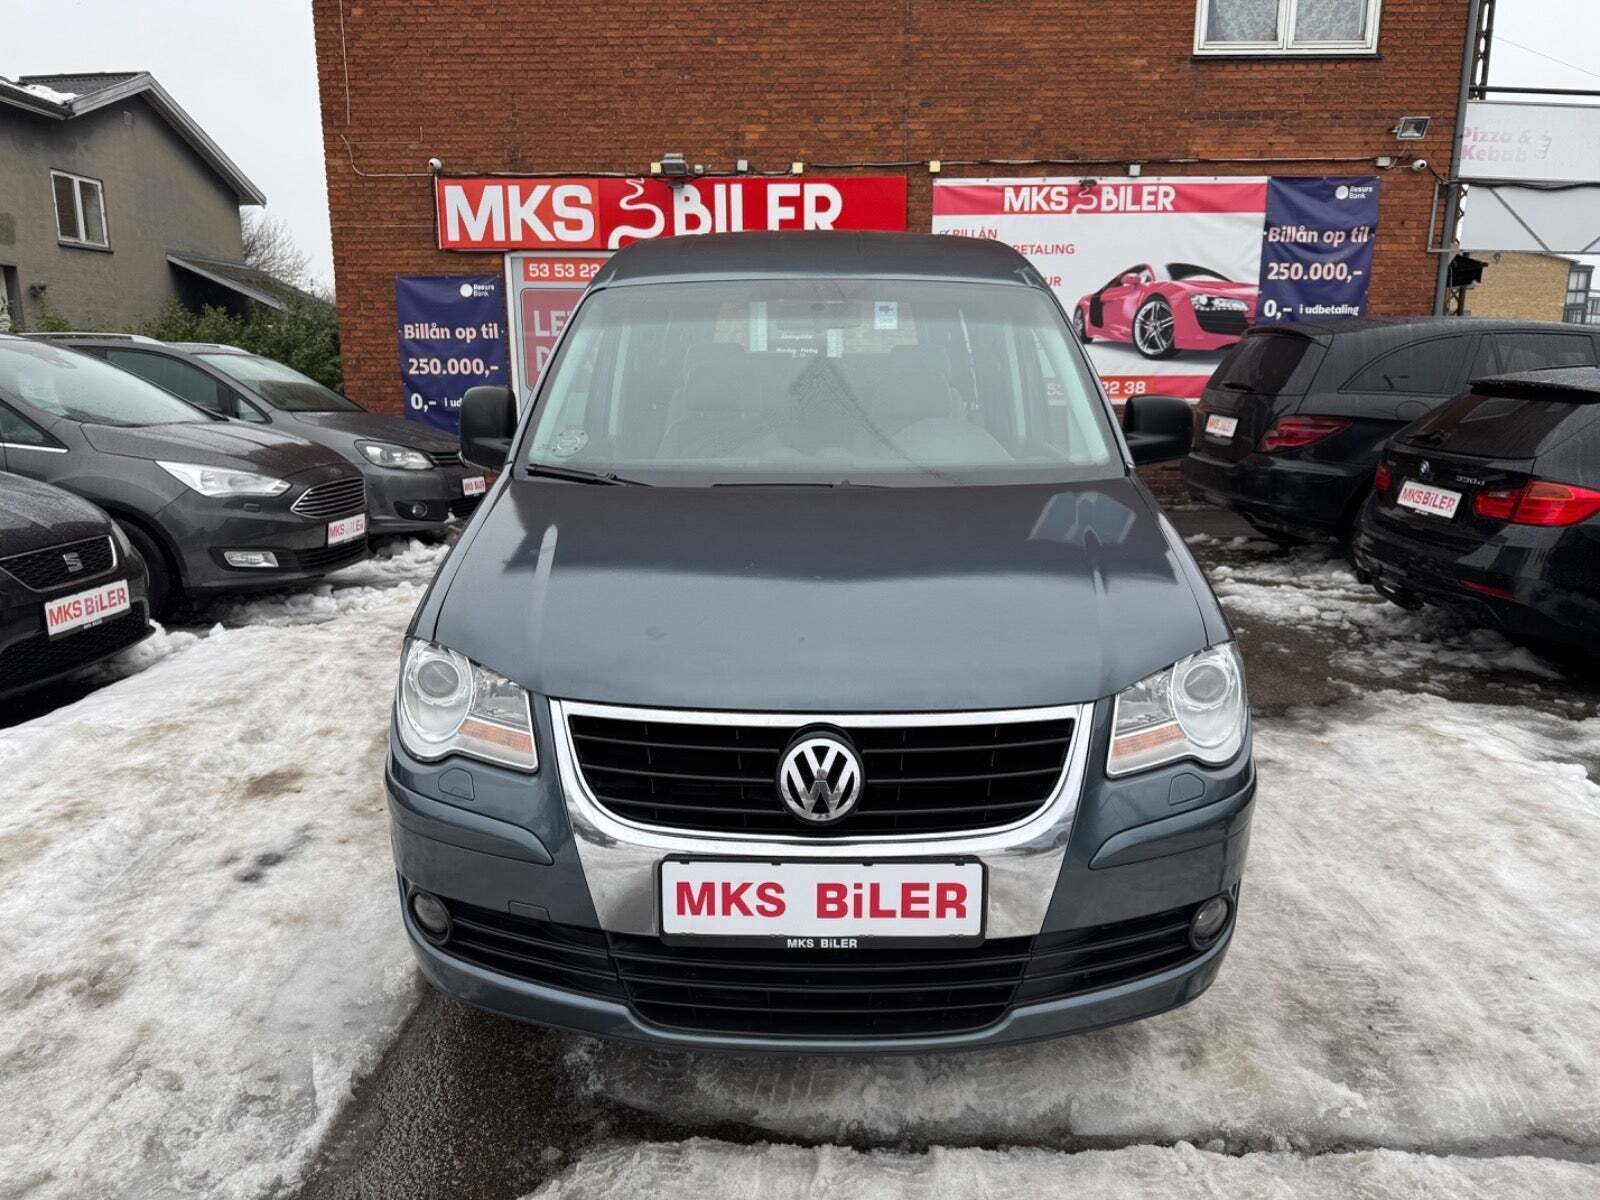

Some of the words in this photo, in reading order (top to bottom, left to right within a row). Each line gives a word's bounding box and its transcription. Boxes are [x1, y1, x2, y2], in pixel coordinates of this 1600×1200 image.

[1003, 186, 1069, 212] MKS
[1100, 186, 1176, 212] BILER
[444, 184, 595, 242] MKS
[1268, 225, 1318, 243] Billån
[1323, 230, 1345, 247] op
[1350, 226, 1369, 243] til
[529, 263, 550, 277] 53
[554, 263, 575, 277] 53
[1267, 262, 1362, 283] 250.000,-
[1305, 304, 1359, 316] udbetaling
[404, 321, 450, 339] Billån
[455, 326, 476, 343] op
[481, 323, 499, 339] til
[408, 357, 499, 378] 250.000,-
[1124, 381, 1146, 394] 38
[48, 600, 82, 627] MKS
[676, 881, 786, 918] MKS
[816, 882, 968, 919] BiLER
[787, 938, 814, 948] MKS
